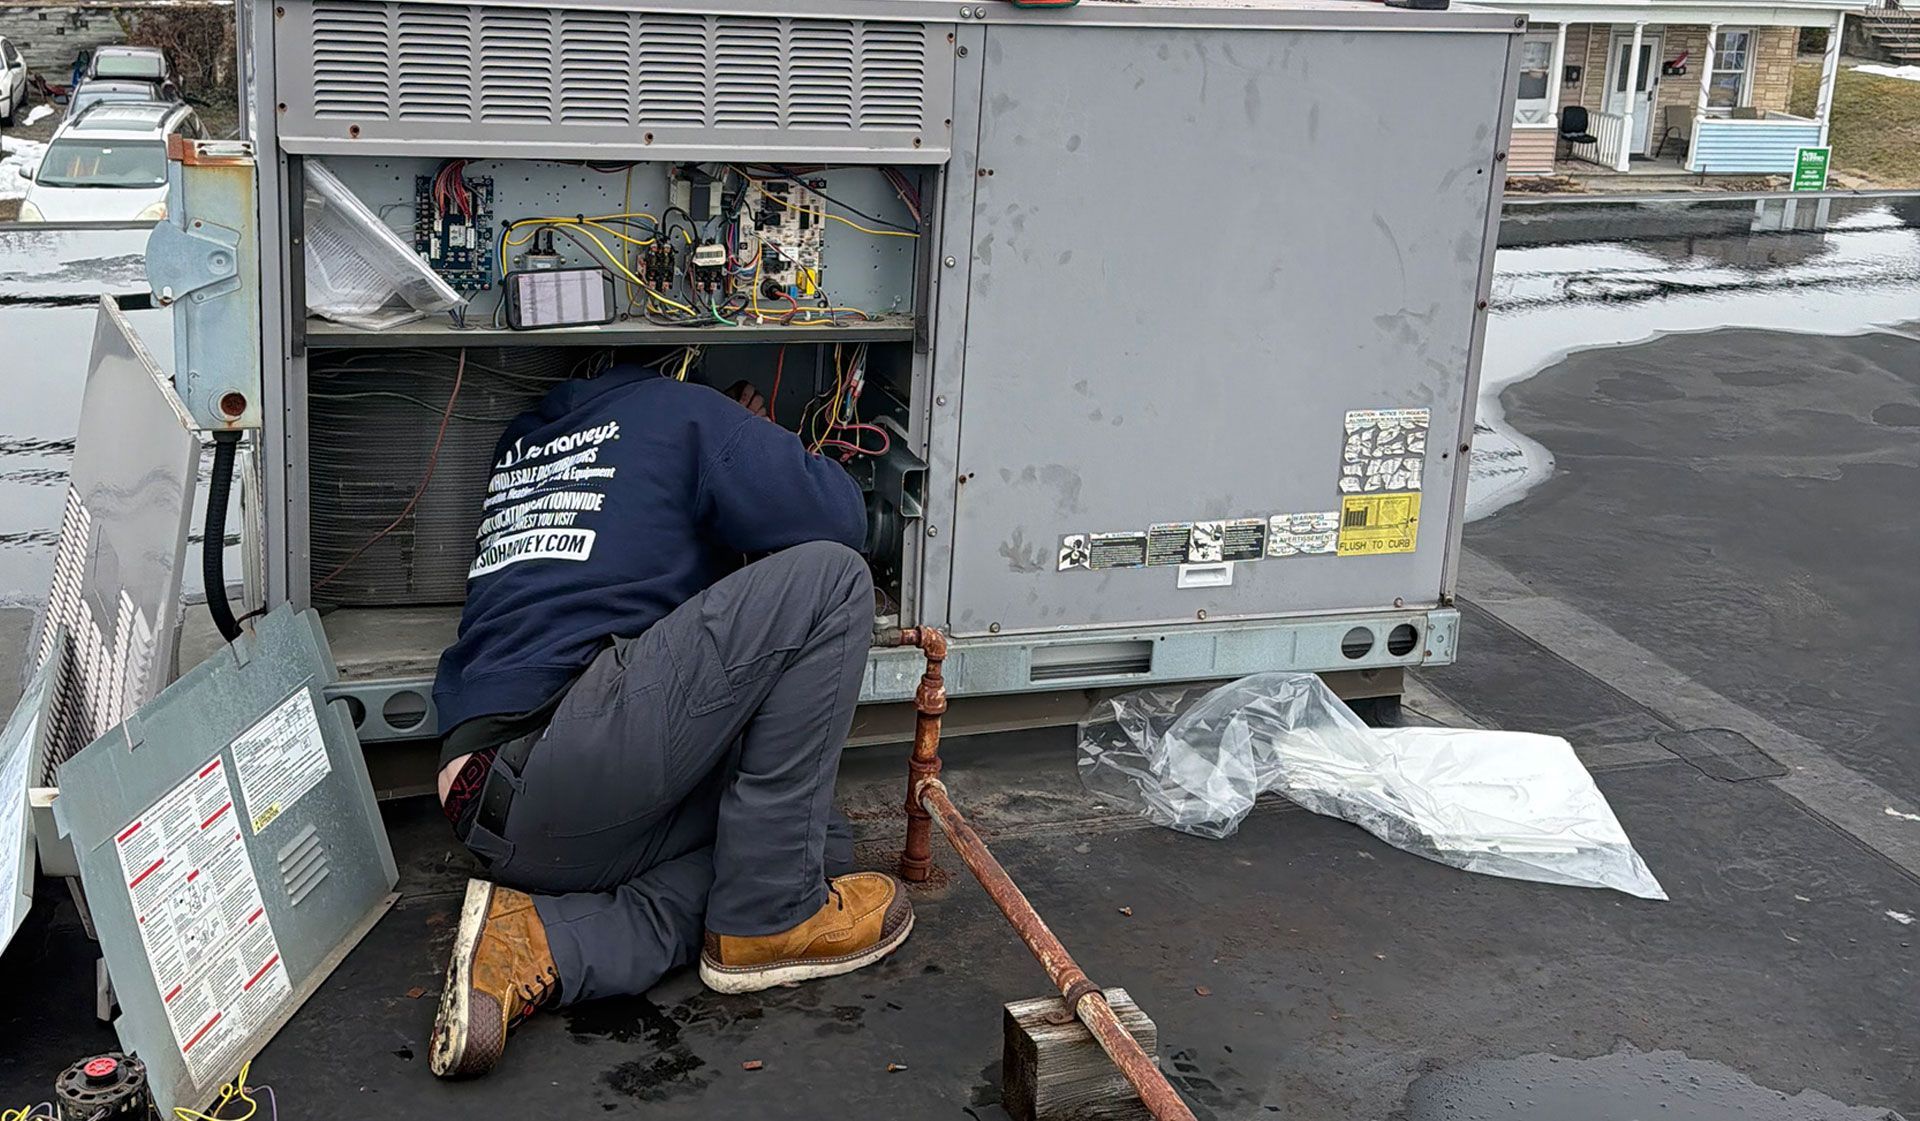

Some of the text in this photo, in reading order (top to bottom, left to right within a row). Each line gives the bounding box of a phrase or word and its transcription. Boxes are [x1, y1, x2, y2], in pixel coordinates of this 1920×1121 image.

[570, 466, 616, 481] Equipment
[537, 513, 555, 528] YOU
[553, 511, 578, 526] VISIT
[1279, 533, 1334, 543] AVERTISSEMENT
[1340, 541, 1367, 551] FLUSH
[1372, 540, 1384, 549] TO
[1388, 539, 1411, 549] CURB
